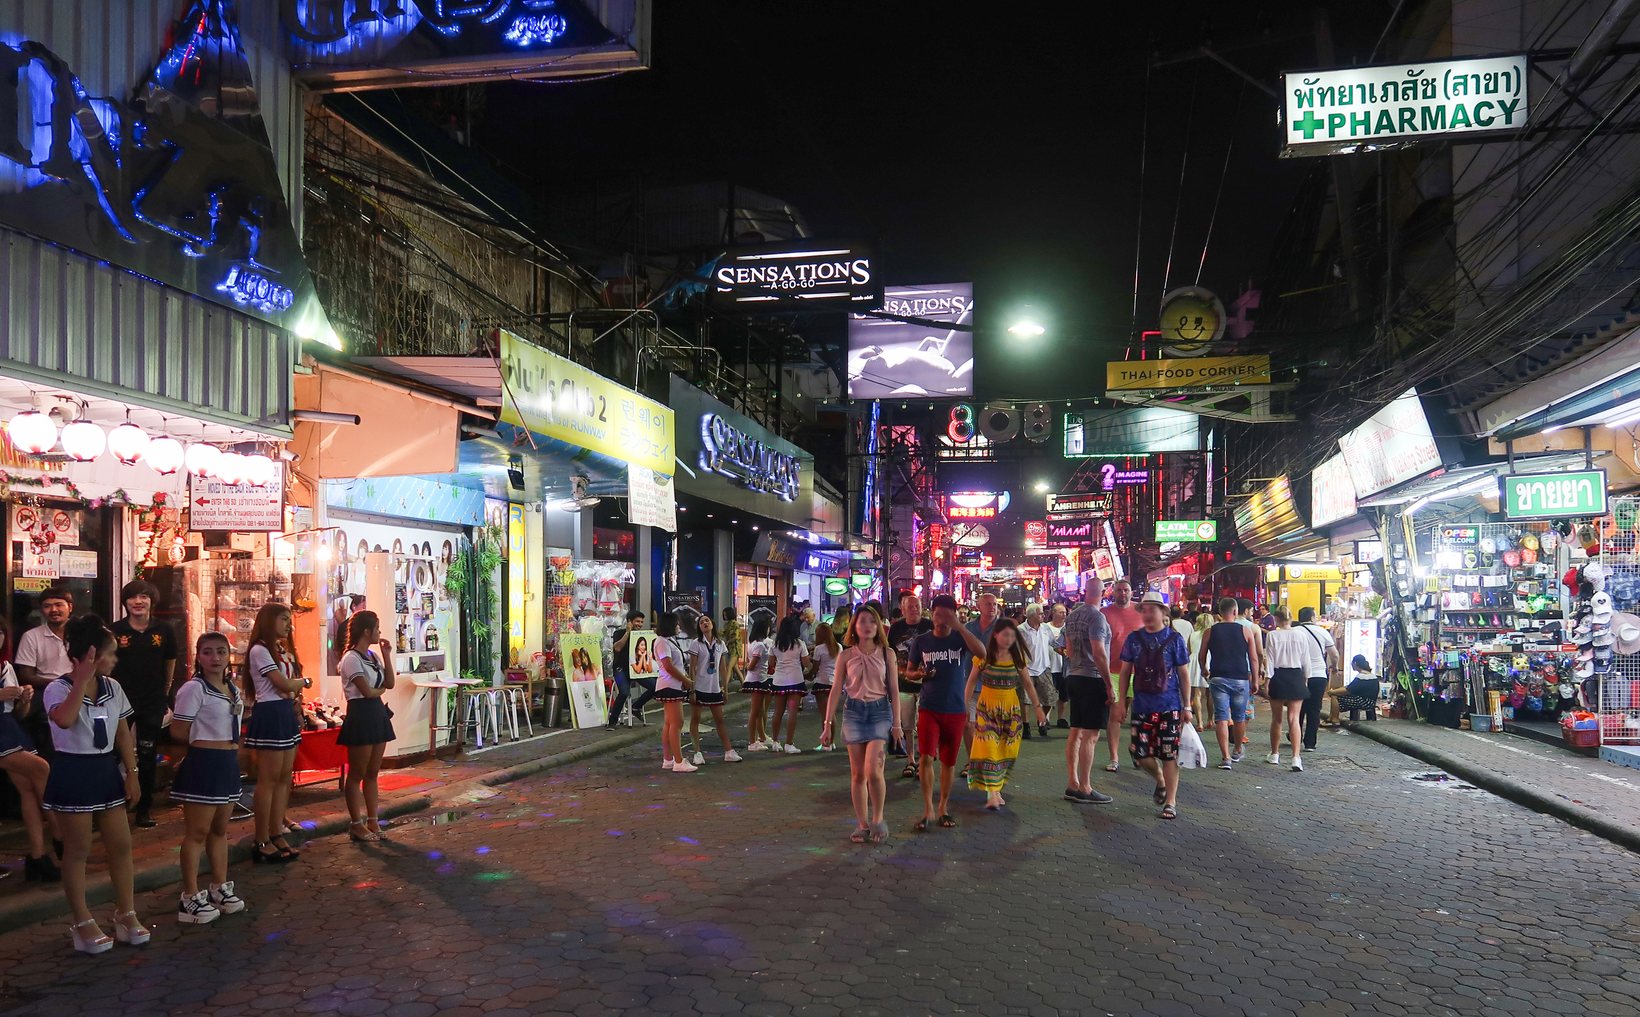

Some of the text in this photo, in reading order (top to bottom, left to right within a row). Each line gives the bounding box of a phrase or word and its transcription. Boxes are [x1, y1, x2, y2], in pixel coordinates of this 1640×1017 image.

[1294, 65, 1521, 109] พัทยาเภสัช (สาขา)
[1328, 99, 1521, 138] PHARMACY
[717, 259, 870, 292] SENSATIONS
[770, 279, 815, 289] A-GO-GO
[1121, 365, 1255, 380] THAI FOOD CORNER
[598, 395, 607, 423] 2
[948, 401, 1052, 443] 808
[570, 420, 607, 440] RUNWAY
[1415, 439, 1441, 465] Street
[1516, 479, 1593, 511] ขายยา
[1444, 529, 1475, 538] OPEN
[26, 568, 57, 577] ห้ามเข้า
